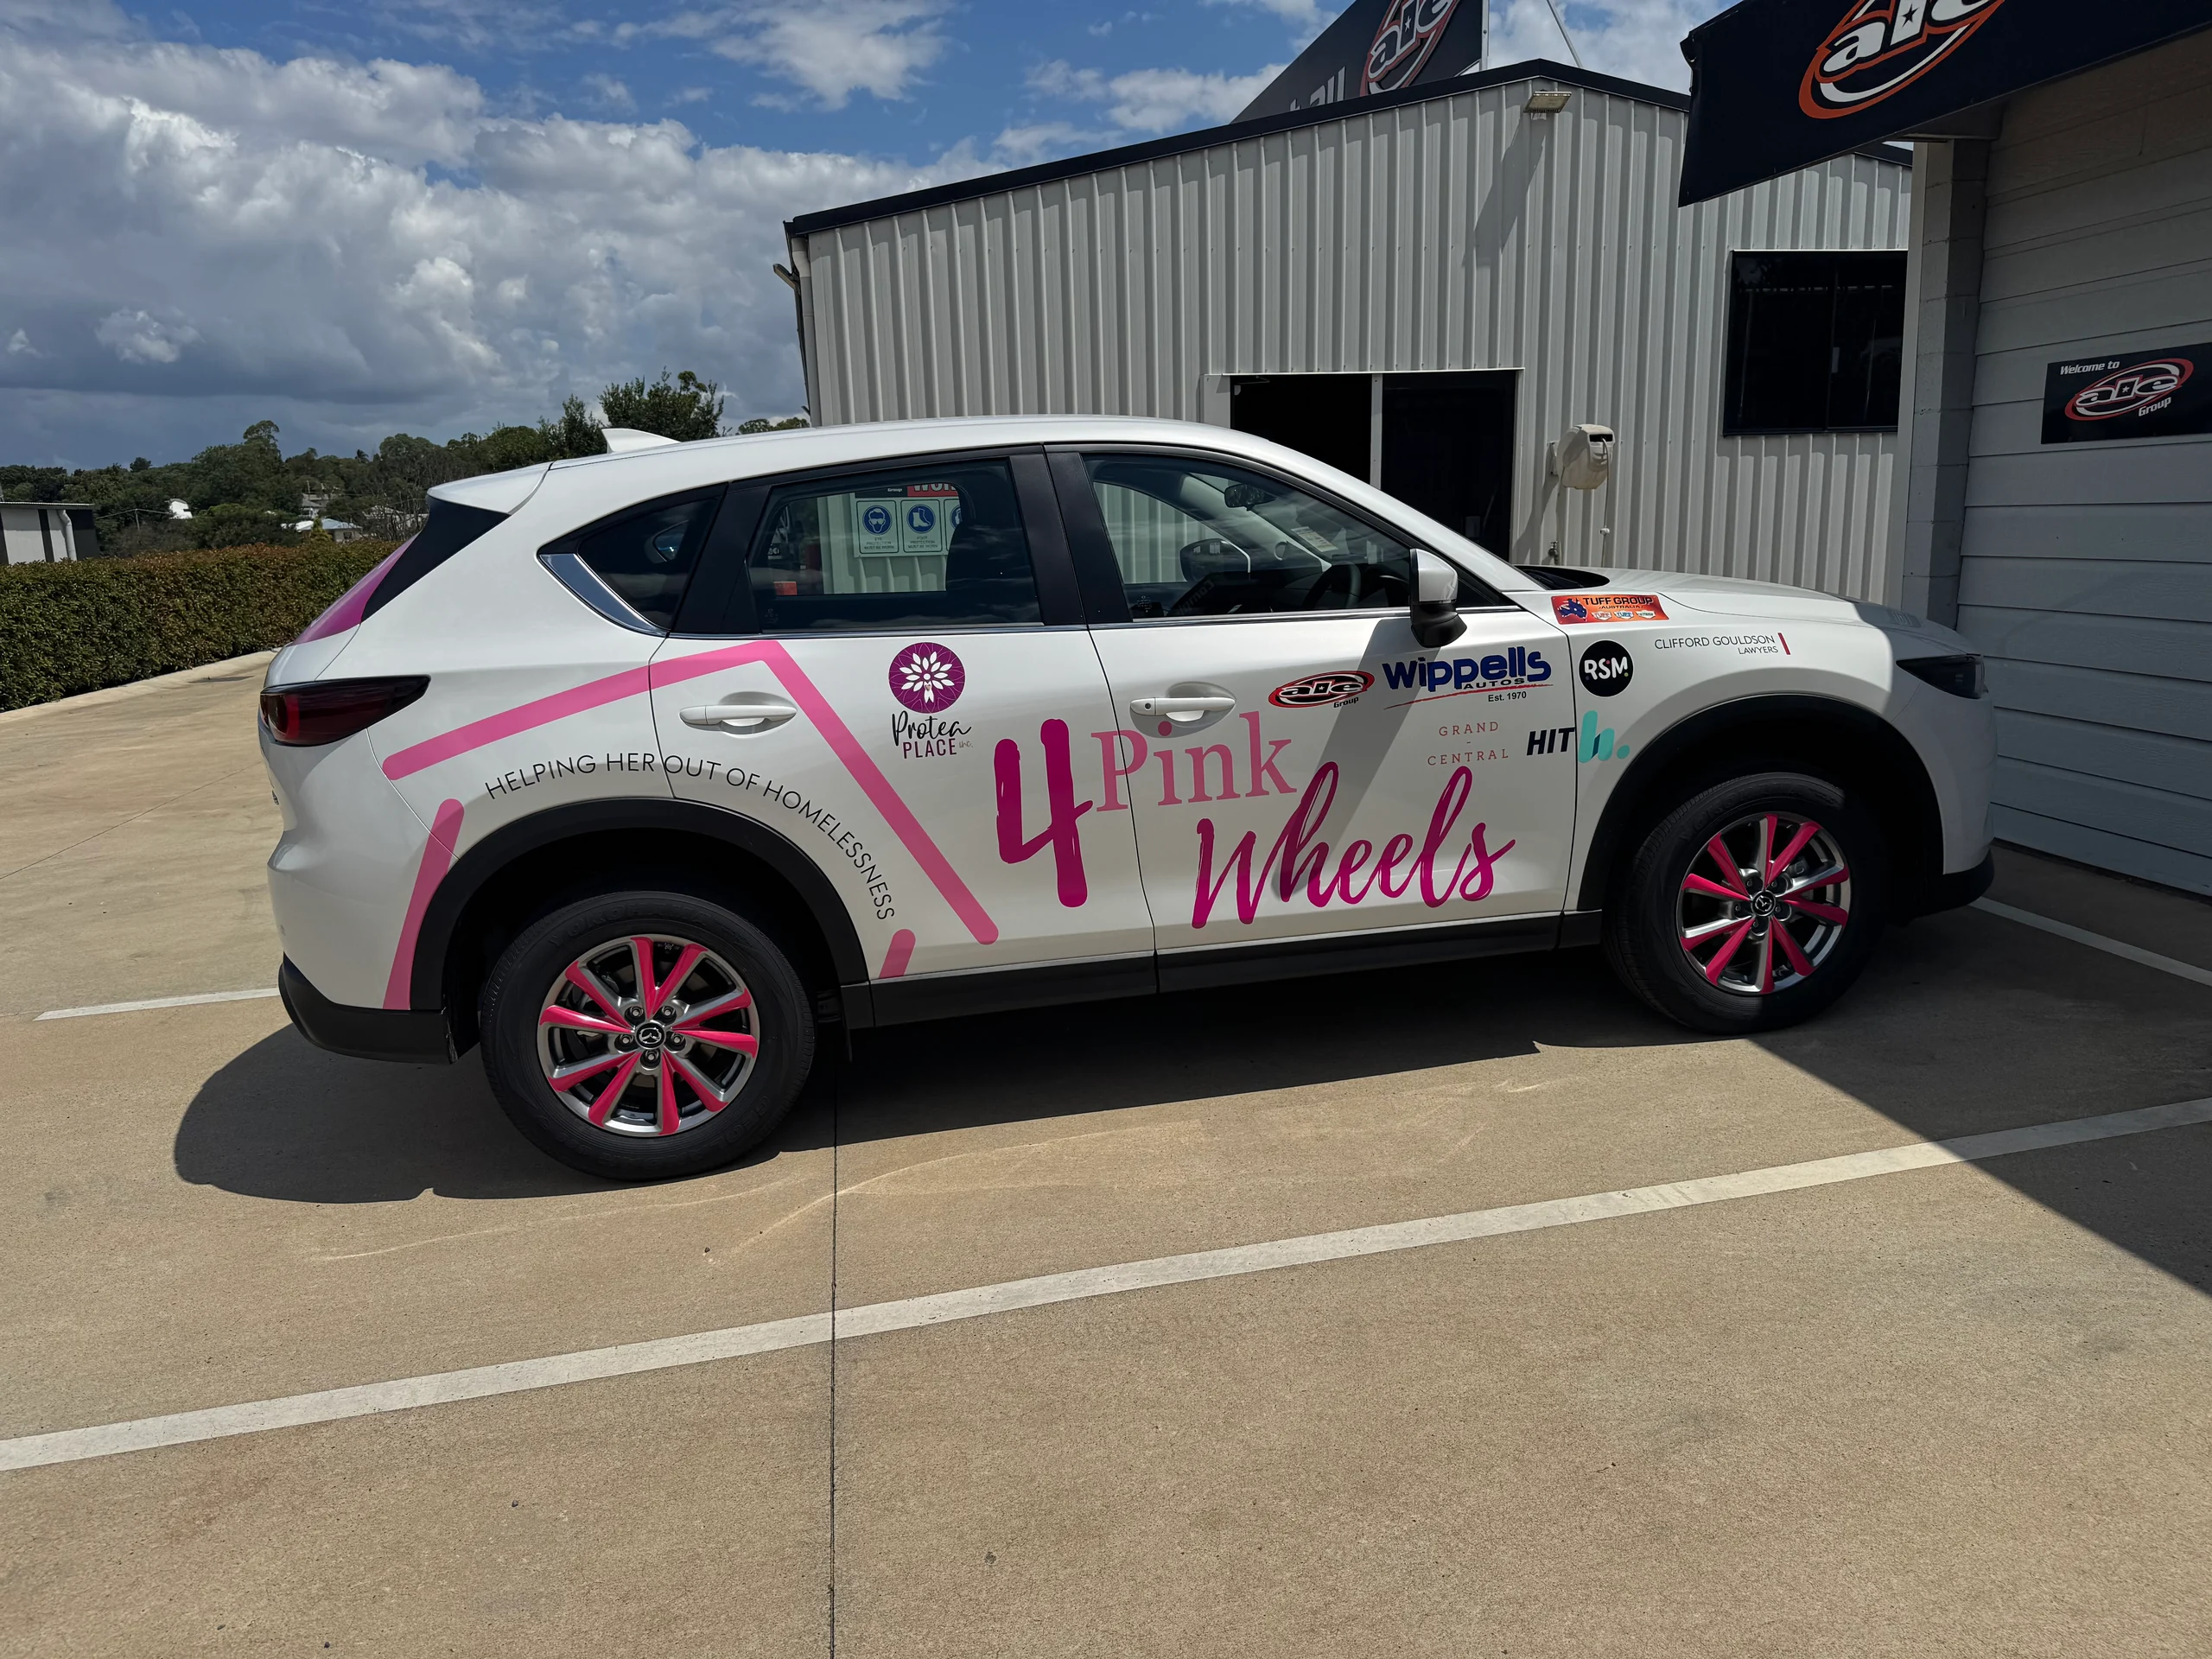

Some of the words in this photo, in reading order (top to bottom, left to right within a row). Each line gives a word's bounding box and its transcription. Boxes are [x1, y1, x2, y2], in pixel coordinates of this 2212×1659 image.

[2060, 362, 2105, 375] Welcome
[2107, 361, 2120, 370] to
[2139, 397, 2171, 416] Group
[1613, 596, 1654, 605] GROUP
[1655, 637, 1710, 650] CLIFFORD
[1713, 634, 1776, 646] GOULDSON
[1738, 645, 1778, 655] LAWYERS
[1382, 646, 1552, 692] Wippells
[1584, 657, 1628, 680] RSM
[1464, 678, 1525, 690] AUTOS
[1333, 696, 1359, 708] Group
[1488, 694, 1504, 702] Est.
[1507, 691, 1527, 701] 1970
[892, 710, 972, 747] Protea
[1439, 721, 1499, 736] GRAND
[902, 738, 957, 760] PLACE
[1526, 727, 1576, 756] HIT
[1427, 749, 1509, 766] CENTRAL
[994, 718, 1094, 908] 4
[1091, 710, 1297, 812] Pink
[486, 754, 596, 799] HELPING
[607, 753, 655, 772] HER
[664, 755, 721, 779] OUT
[726, 767, 760, 790] OF
[763, 779, 895, 920] HOMELESSNESS
[1192, 761, 1516, 930] Wheels
